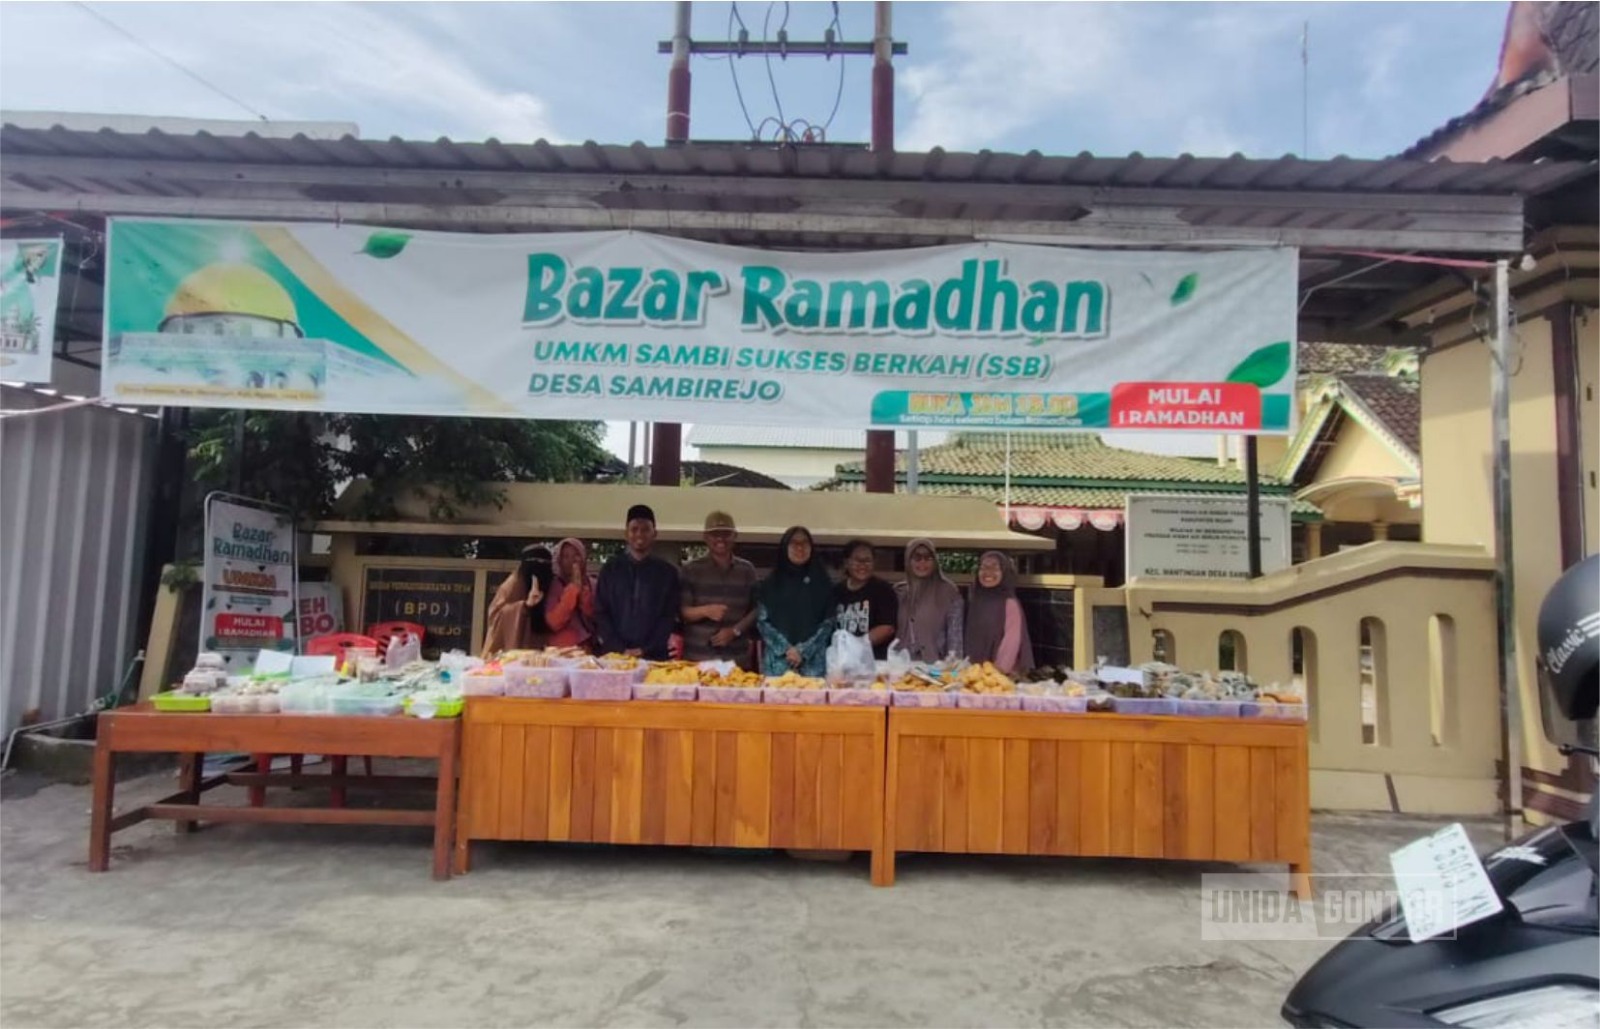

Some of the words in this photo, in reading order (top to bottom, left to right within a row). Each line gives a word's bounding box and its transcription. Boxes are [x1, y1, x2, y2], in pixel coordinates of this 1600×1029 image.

[521, 251, 727, 327] Bazar
[740, 257, 1108, 337] Ramadhan
[533, 341, 629, 364] UMKM
[635, 343, 730, 367] SAMBI
[736, 347, 847, 372] SUKSES
[853, 352, 971, 376] BERKAH
[975, 353, 1052, 379] (SSB)
[528, 373, 602, 395] DESA
[608, 374, 782, 401] SAMBIREJO
[1147, 387, 1222, 406] MULAI
[1129, 409, 1245, 426] RAMADHAN
[231, 521, 277, 545] Bazar
[212, 537, 291, 564] Ramadhan
[232, 616, 266, 627] MULAI
[1547, 628, 1585, 674] Classic
